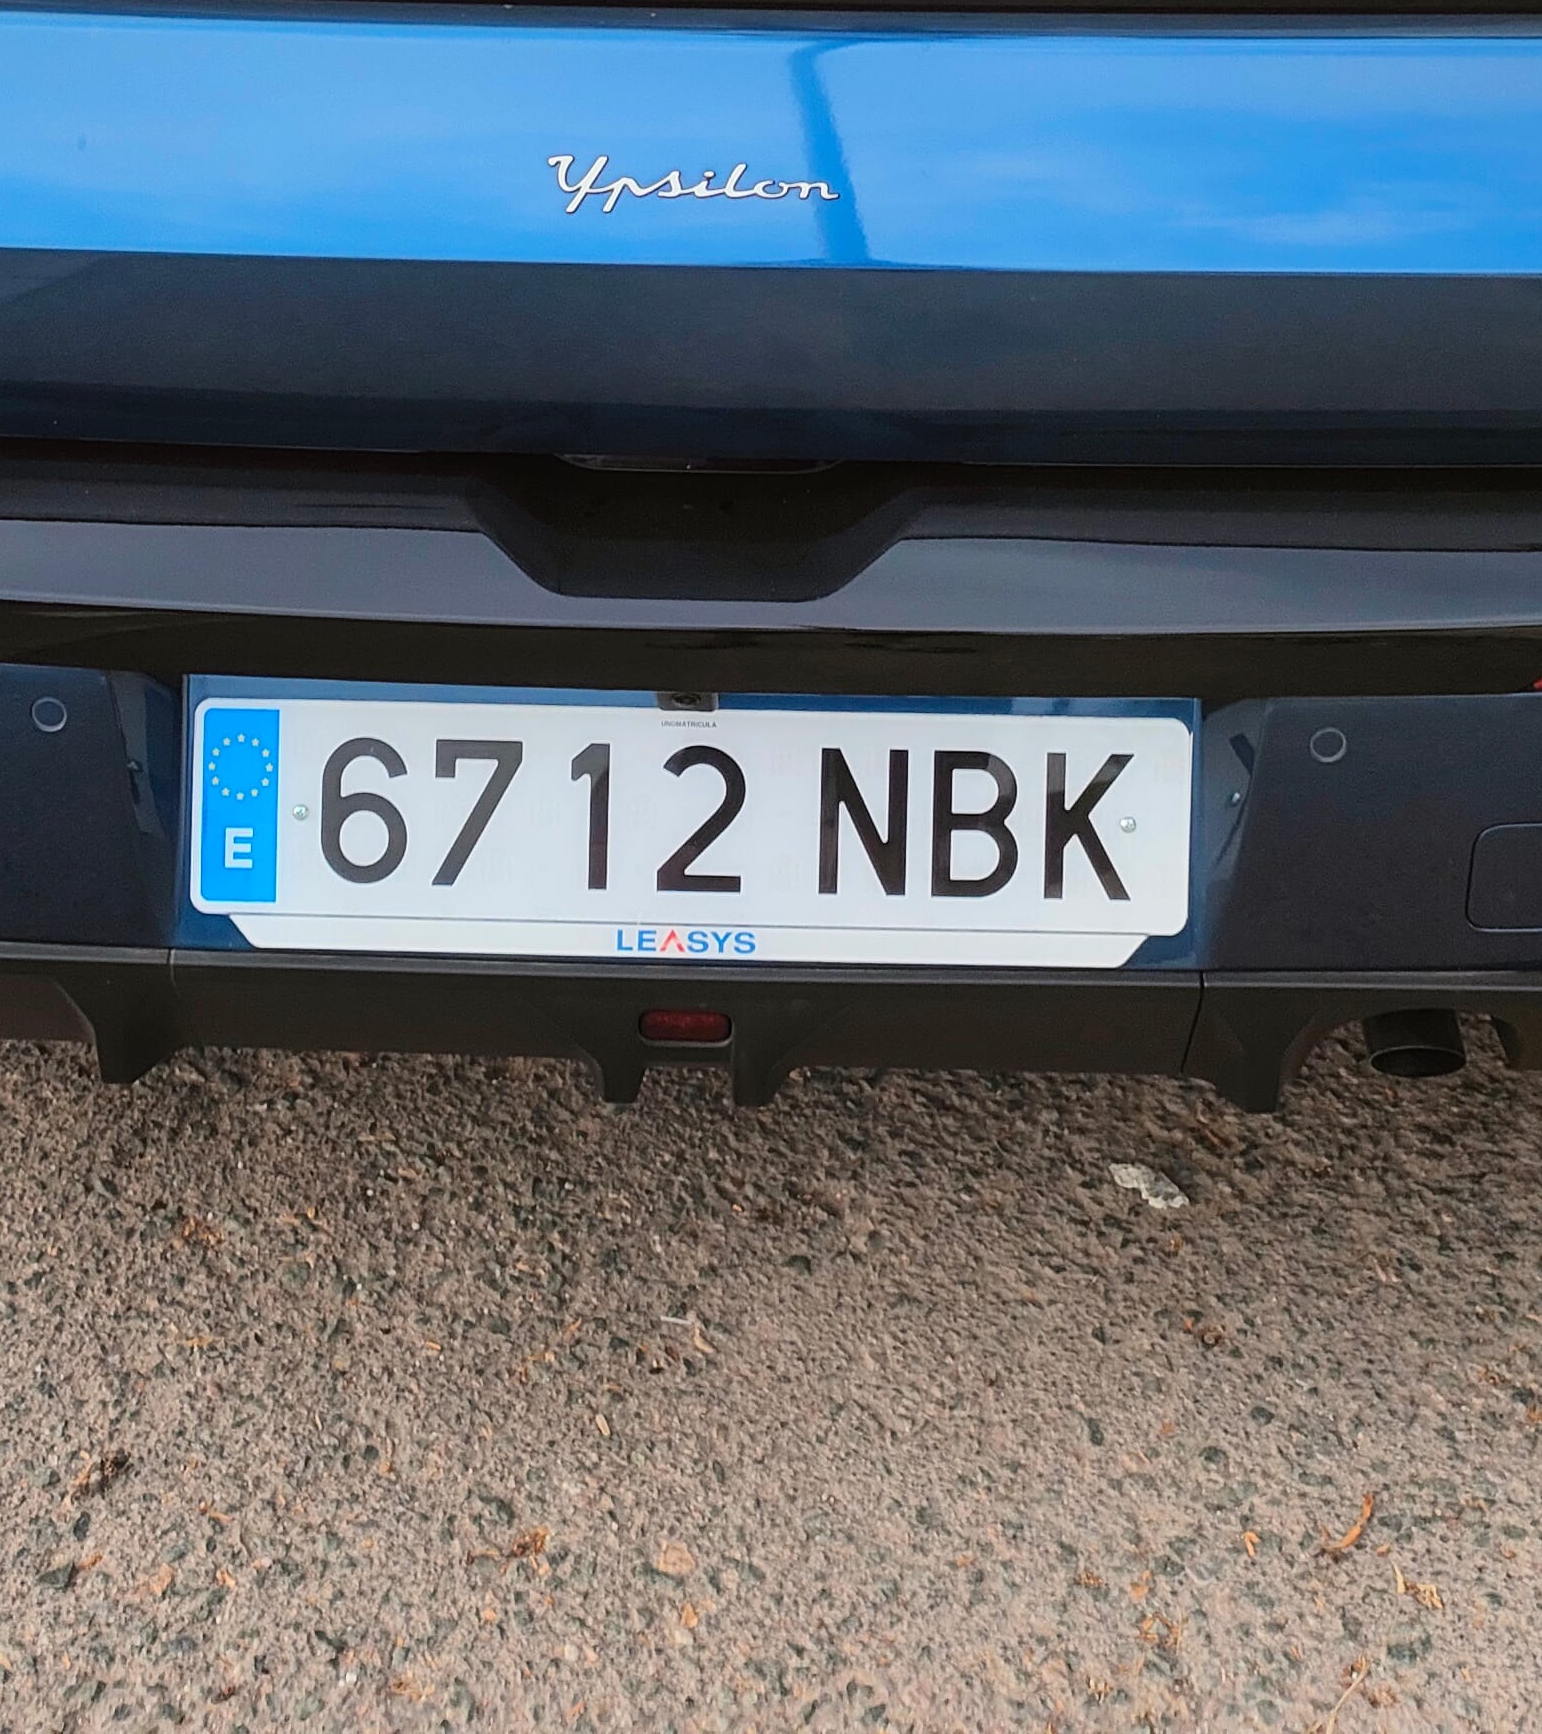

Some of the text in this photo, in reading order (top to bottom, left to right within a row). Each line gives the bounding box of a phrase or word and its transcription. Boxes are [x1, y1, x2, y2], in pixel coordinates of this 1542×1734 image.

[547, 153, 840, 215] Ypsilon
[320, 737, 1135, 901] 6712 NBK
[223, 828, 255, 870] E
[616, 929, 756, 954] LEASYS
